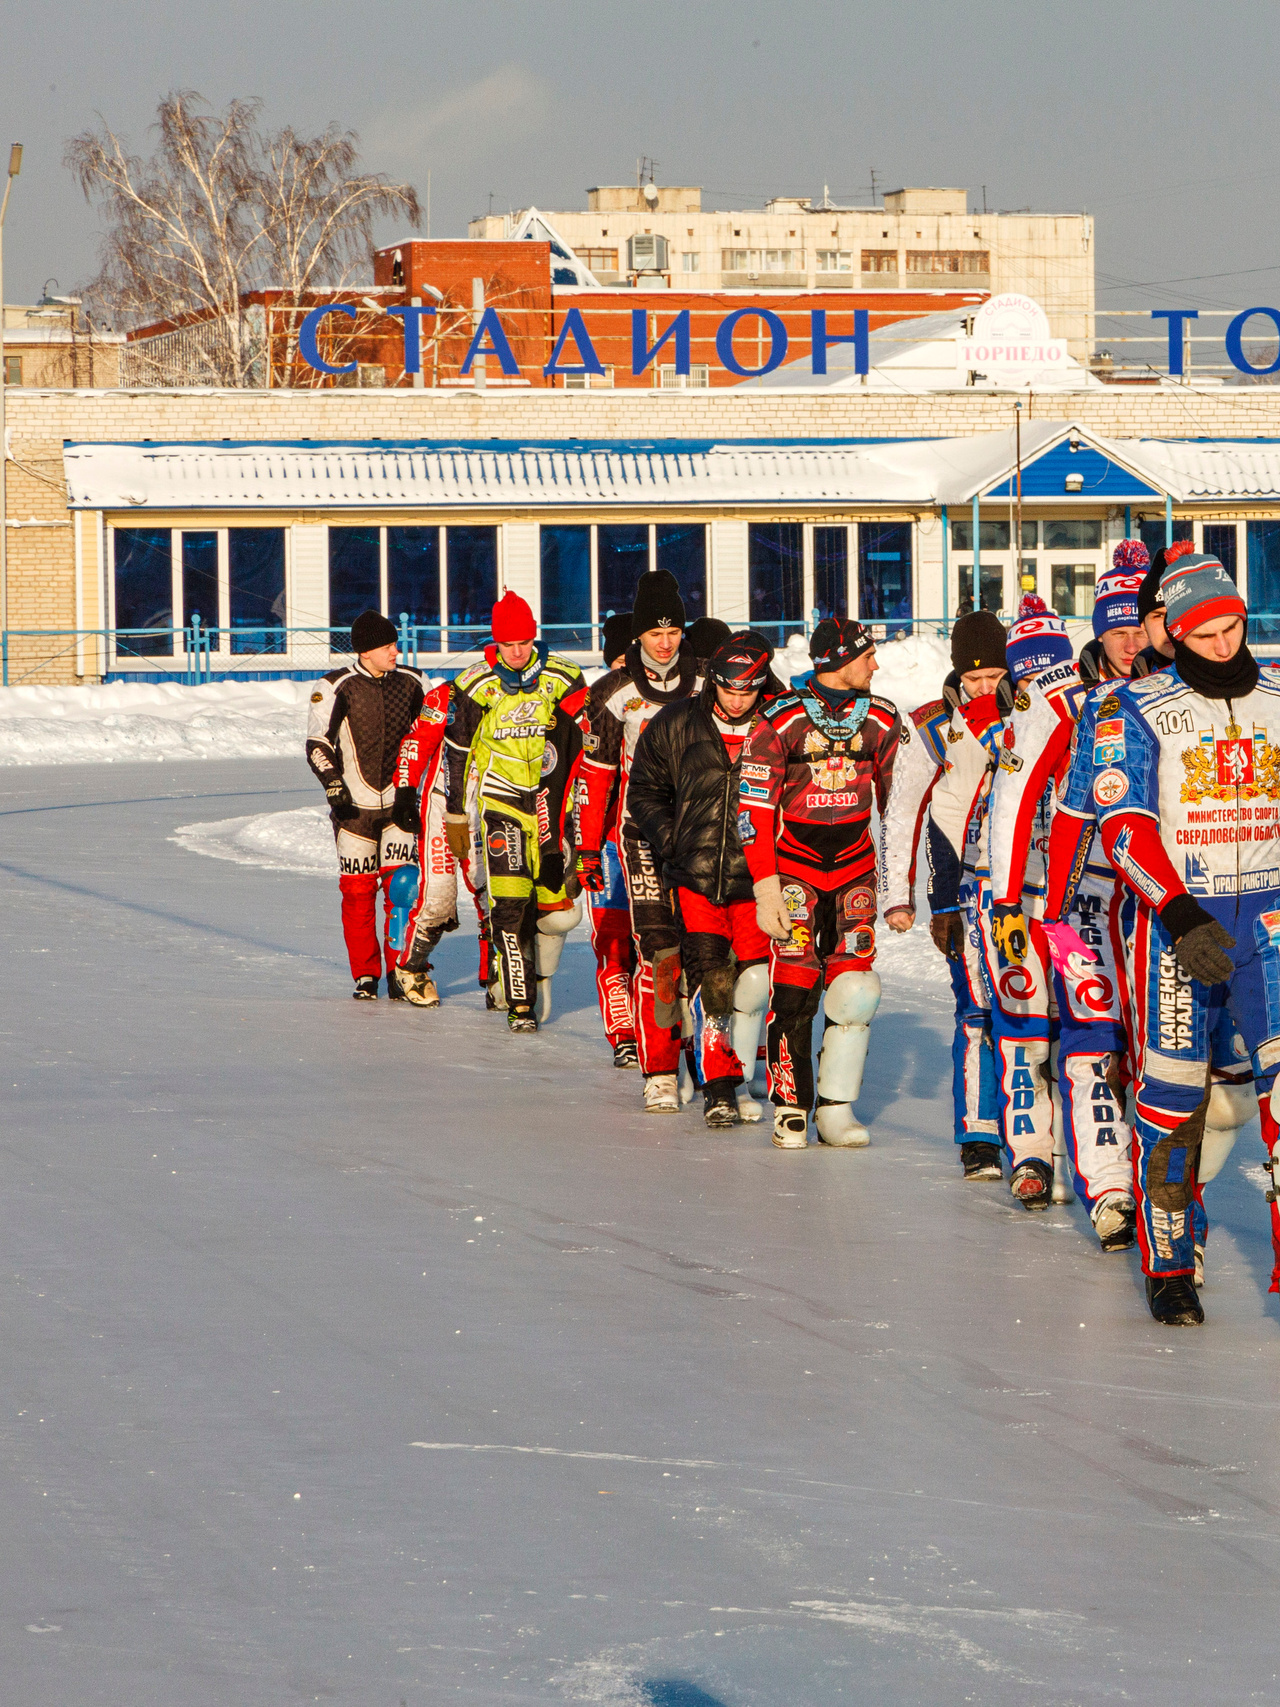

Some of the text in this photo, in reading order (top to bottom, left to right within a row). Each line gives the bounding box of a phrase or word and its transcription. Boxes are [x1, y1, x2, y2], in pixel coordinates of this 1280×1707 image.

[985, 297, 1039, 317] СТАДИОН
[298, 303, 870, 377] СТАДИОН
[962, 346, 1061, 363] ТОРПЕДО
[1107, 609, 1122, 617] MEGA
[854, 636, 867, 648] ICE
[1036, 665, 1076, 690] MEGA
[493, 725, 547, 740] ИРКУТС
[1156, 709, 1195, 735] 101
[398, 740, 411, 787] RACING
[408, 739, 419, 762] ICE
[578, 778, 590, 806] ICE
[807, 793, 858, 808] RUSSIA
[1254, 807, 1279, 820] СПОРТА
[340, 854, 376, 874] SHAAZ
[431, 837, 444, 875] АВТО
[638, 839, 660, 901] RACING
[1214, 868, 1280, 895] УРАЛРАНСТРОМ
[633, 873, 645, 900] ICE
[504, 931, 526, 999] ИРКУТСК
[1160, 945, 1177, 1050] КАМЕНСК-
[1176, 964, 1194, 1050] УРАЛЬС
[780, 1032, 798, 1105] FEAR
[1011, 1046, 1036, 1136] LADA
